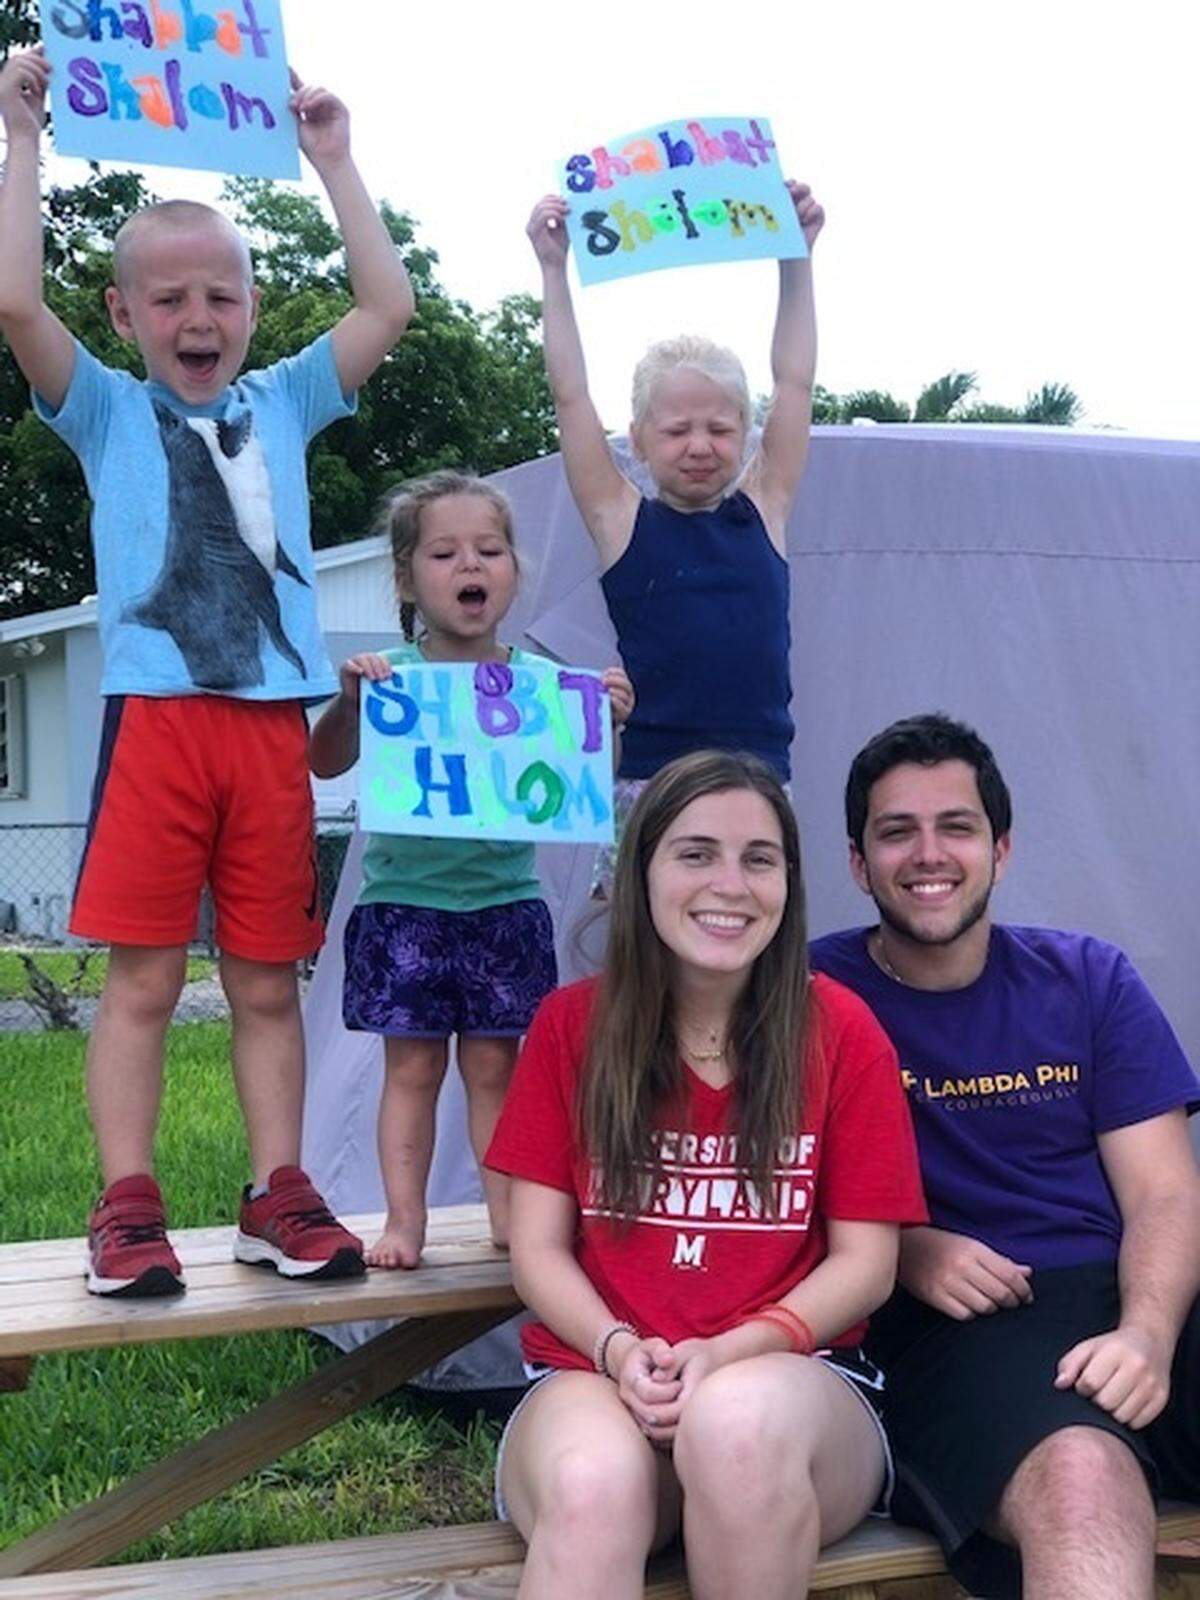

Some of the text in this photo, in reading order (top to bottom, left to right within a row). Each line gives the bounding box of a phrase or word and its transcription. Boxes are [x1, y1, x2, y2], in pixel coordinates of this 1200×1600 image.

[66, 56, 277, 131] Shalom
[924, 1072, 1031, 1098] LAMBDA
[1036, 1064, 1079, 1087] PHI
[777, 1134, 816, 1166] OF
[671, 1233, 706, 1267] M
